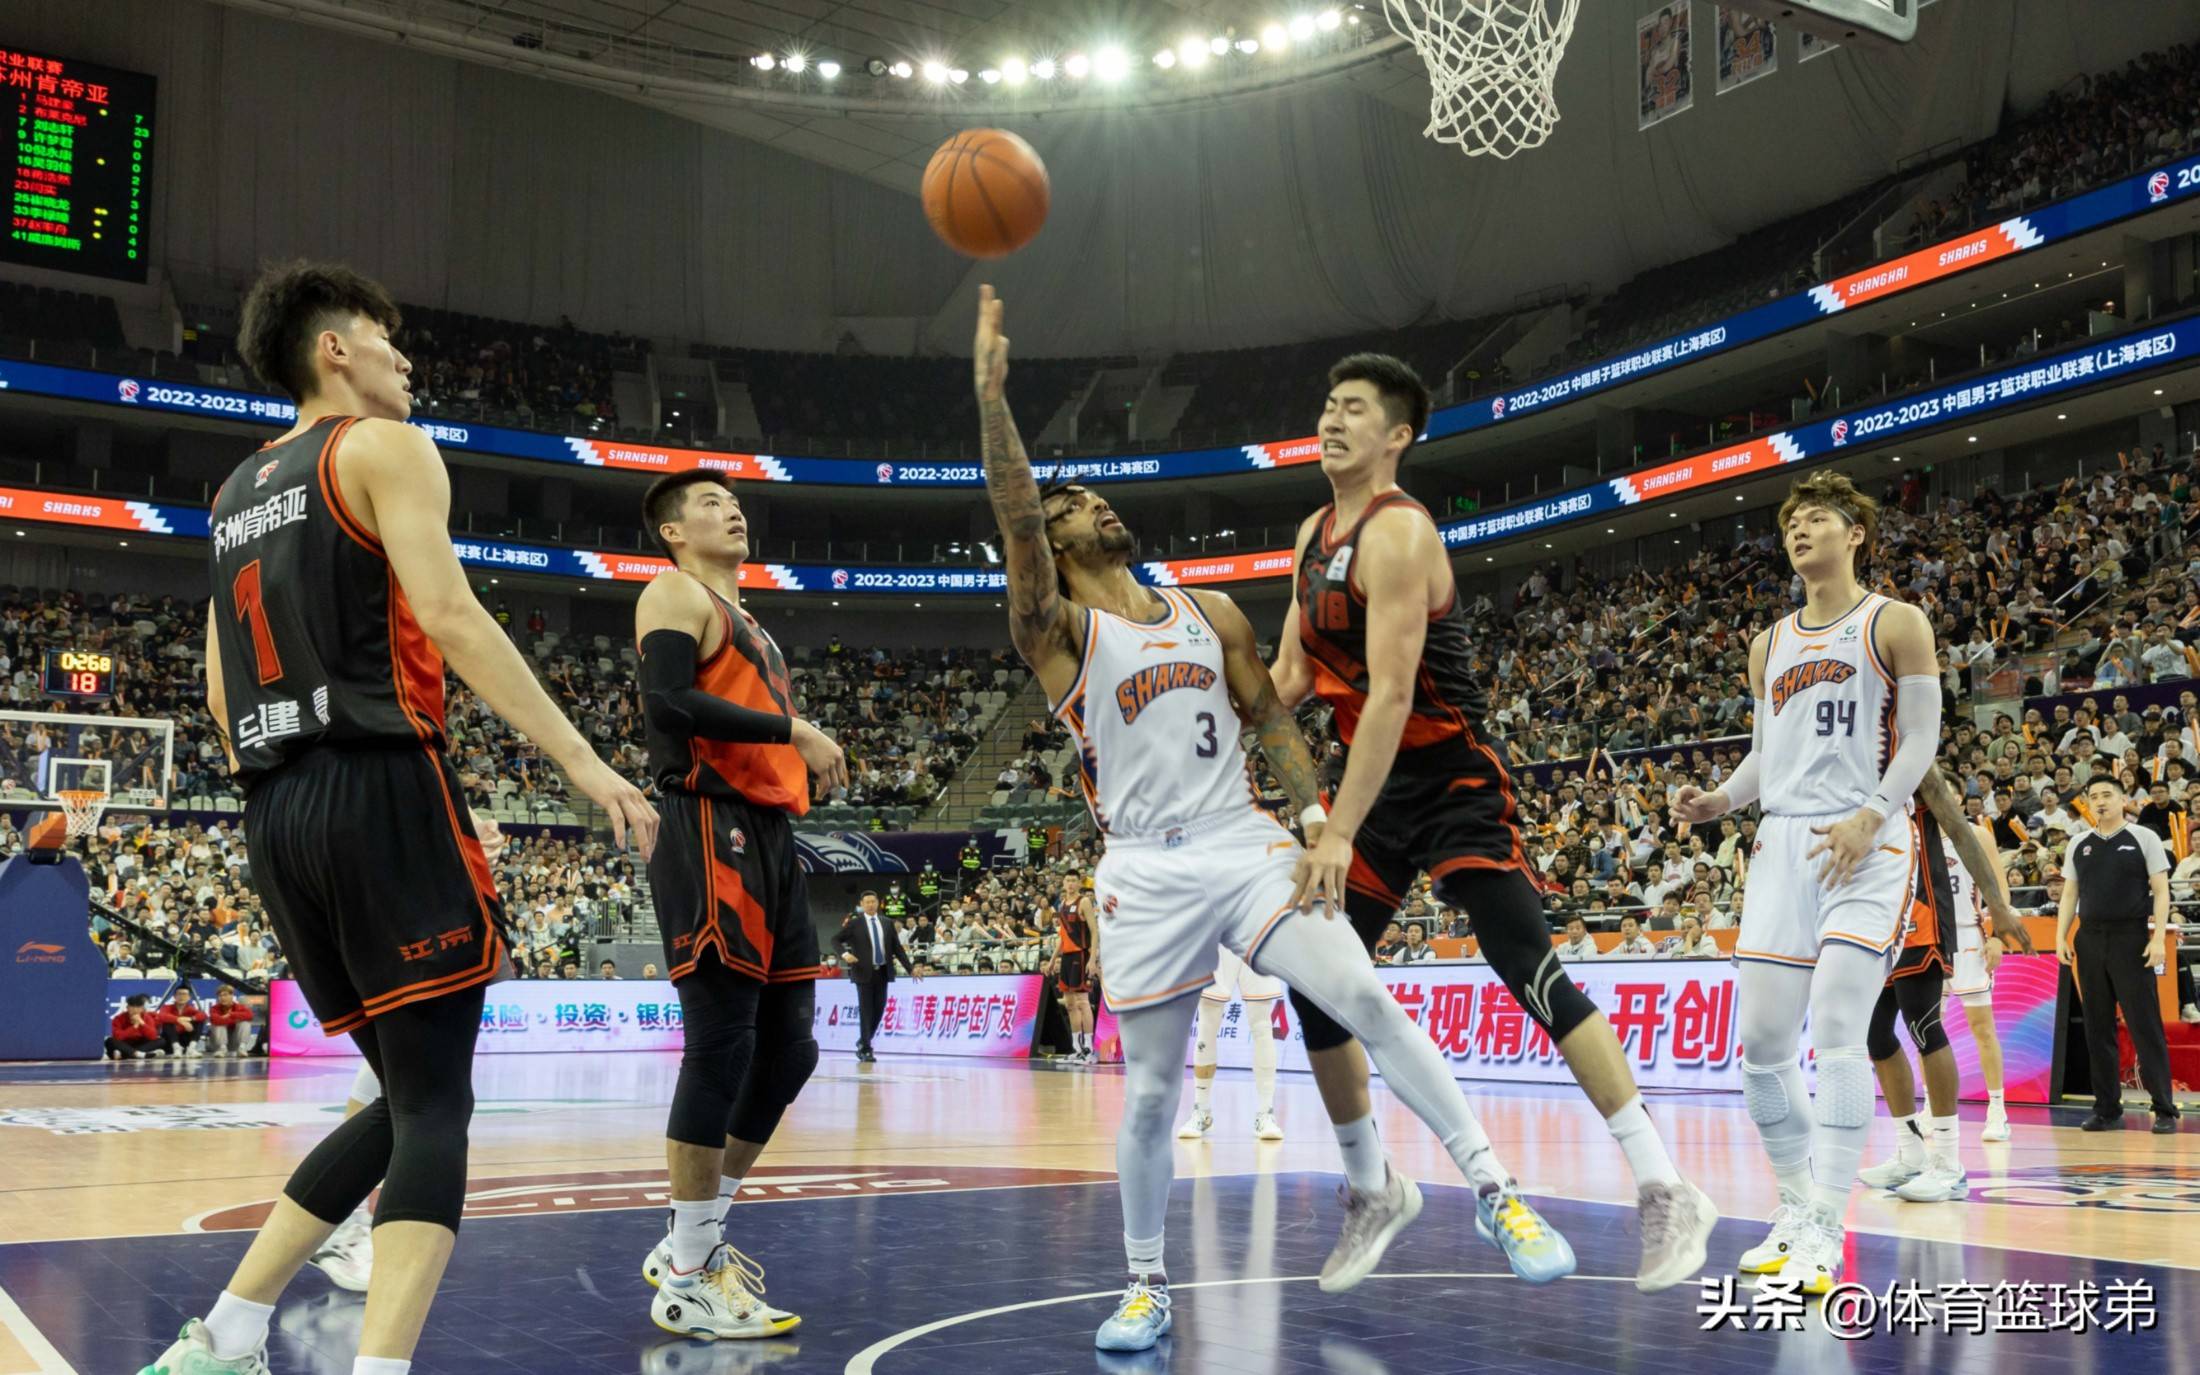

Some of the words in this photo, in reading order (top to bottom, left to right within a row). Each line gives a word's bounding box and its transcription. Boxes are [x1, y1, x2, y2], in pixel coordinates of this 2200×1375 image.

[1849, 266, 1908, 296] SHANGHAI
[1939, 240, 1987, 267] SHARKS
[147, 386, 247, 413] 2022-2023
[1509, 380, 1570, 412] 2022-2023
[1854, 398, 1940, 437] 2022-2023
[1942, 332, 2177, 413] 中国男子篮球职业联赛(上海赛区)
[608, 449, 669, 465] SHANGHAI
[698, 458, 743, 471] SHARKS
[899, 466, 978, 481] 2022-2023
[1643, 467, 1693, 492] SHANGHAI
[1712, 451, 1752, 473] SHARKS
[43, 501, 102, 518] SHARKS
[855, 573, 935, 587] 2022-2023
[1182, 563, 1234, 578] SHANGHAI
[1253, 556, 1292, 572] SHARKS
[233, 559, 283, 686] 1
[71, 673, 97, 693] 18
[1115, 661, 1217, 726] SHARKS
[1772, 658, 1857, 717] SHARKS
[1195, 711, 1218, 759] 3
[1816, 700, 1857, 737] 94
[16, 955, 66, 964] LI-NING
[939, 994, 1016, 1033] 开户在广发
[464, 1178, 950, 1211] LI-ING
